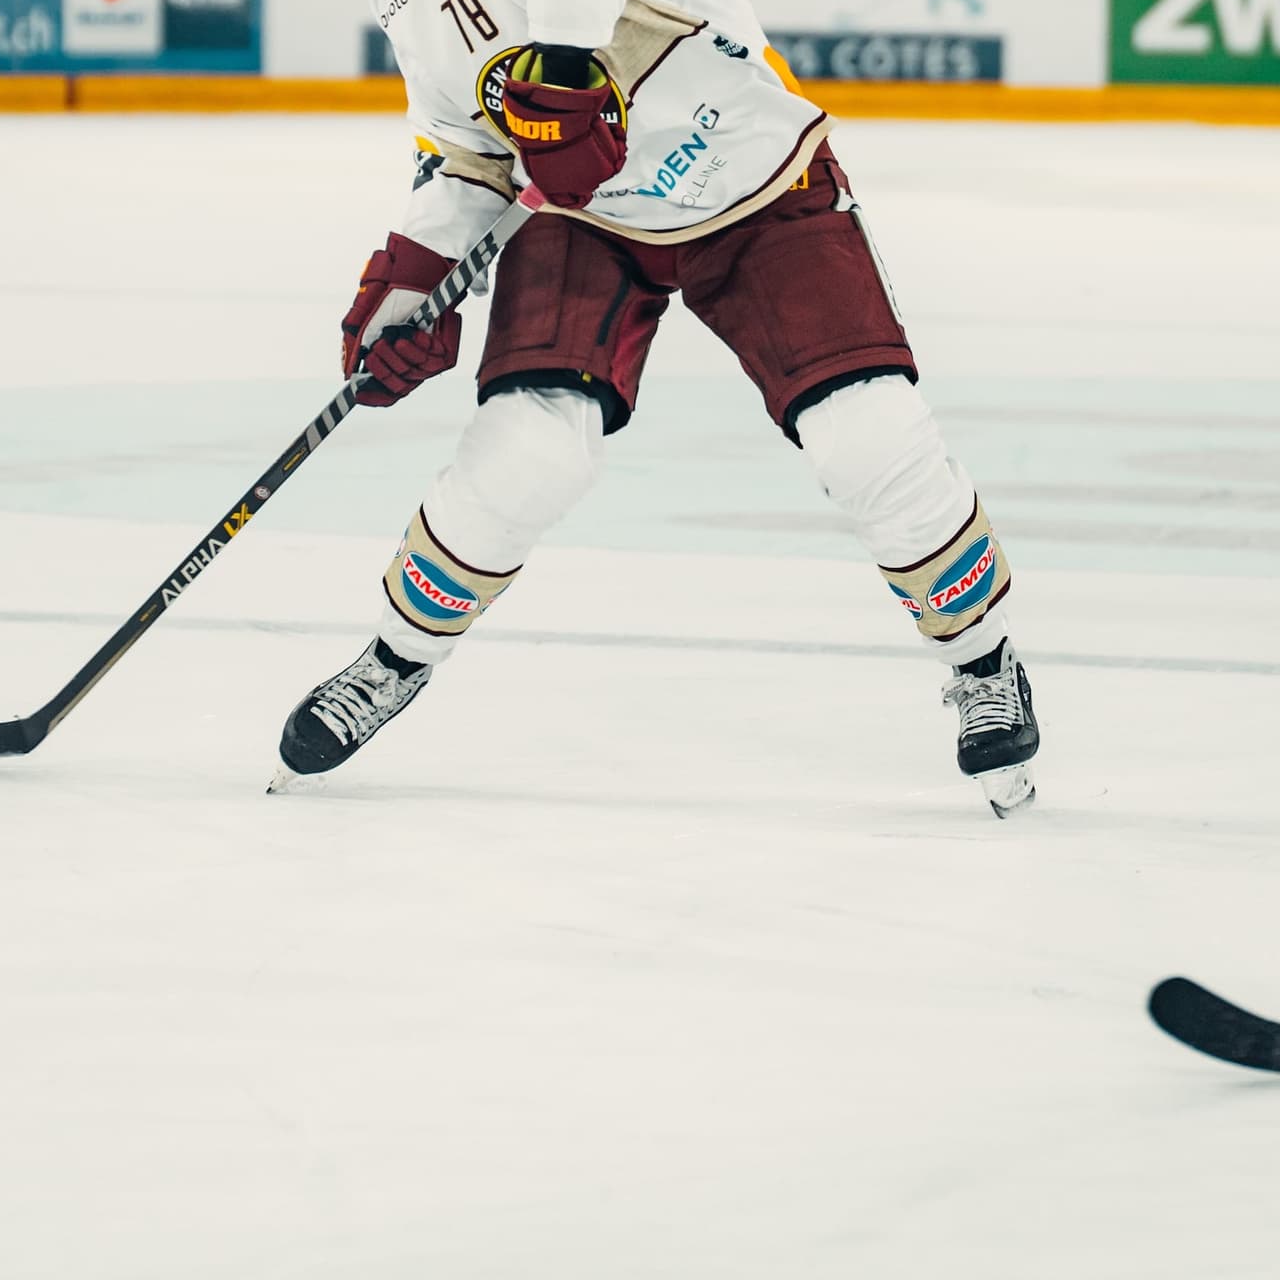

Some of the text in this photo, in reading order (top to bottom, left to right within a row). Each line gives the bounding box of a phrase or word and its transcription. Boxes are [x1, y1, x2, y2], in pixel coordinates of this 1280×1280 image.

[679, 154, 728, 209] OLLINE
[160, 538, 226, 608] ALPHA
[404, 556, 474, 612] TAMOIL
